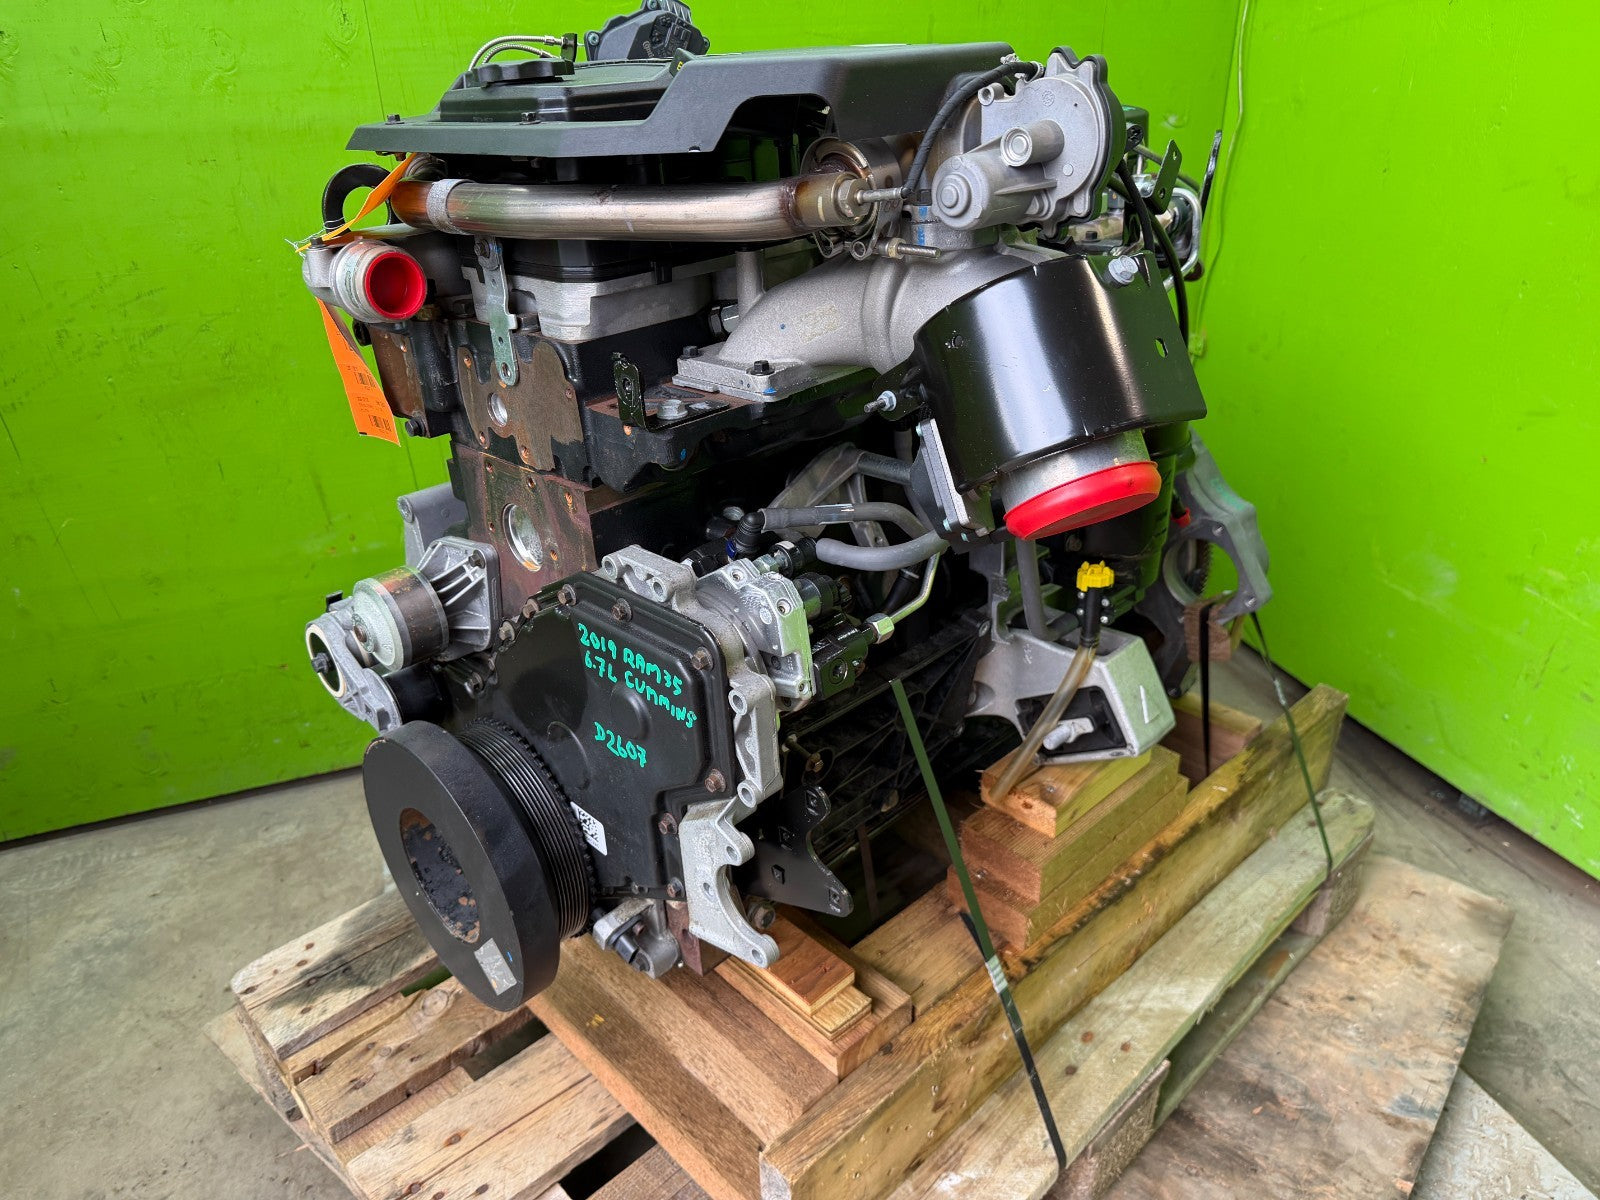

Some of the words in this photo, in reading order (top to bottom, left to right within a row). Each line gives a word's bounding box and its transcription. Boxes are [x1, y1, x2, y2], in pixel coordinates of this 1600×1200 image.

[578, 623, 617, 660] 2019
[584, 651, 618, 684] 6.7L
[624, 670, 698, 729] CUMMINS
[594, 722, 648, 768] D2607
